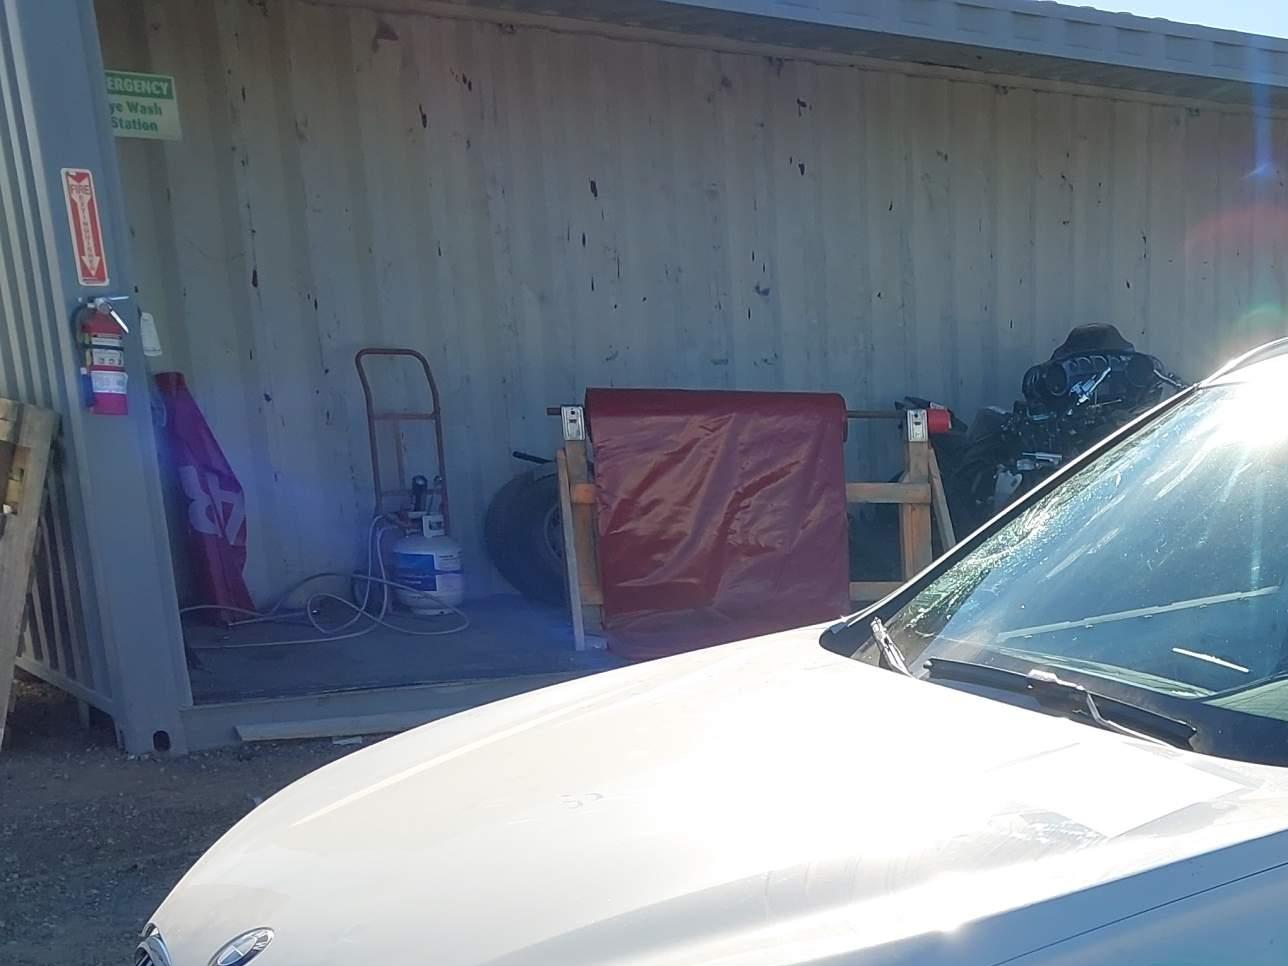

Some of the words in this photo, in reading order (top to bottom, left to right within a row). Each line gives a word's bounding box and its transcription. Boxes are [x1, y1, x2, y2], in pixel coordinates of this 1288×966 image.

[106, 77, 169, 95] ERGENCY
[108, 102, 123, 115] ye
[125, 100, 163, 116] Wash
[111, 116, 159, 132] Station
